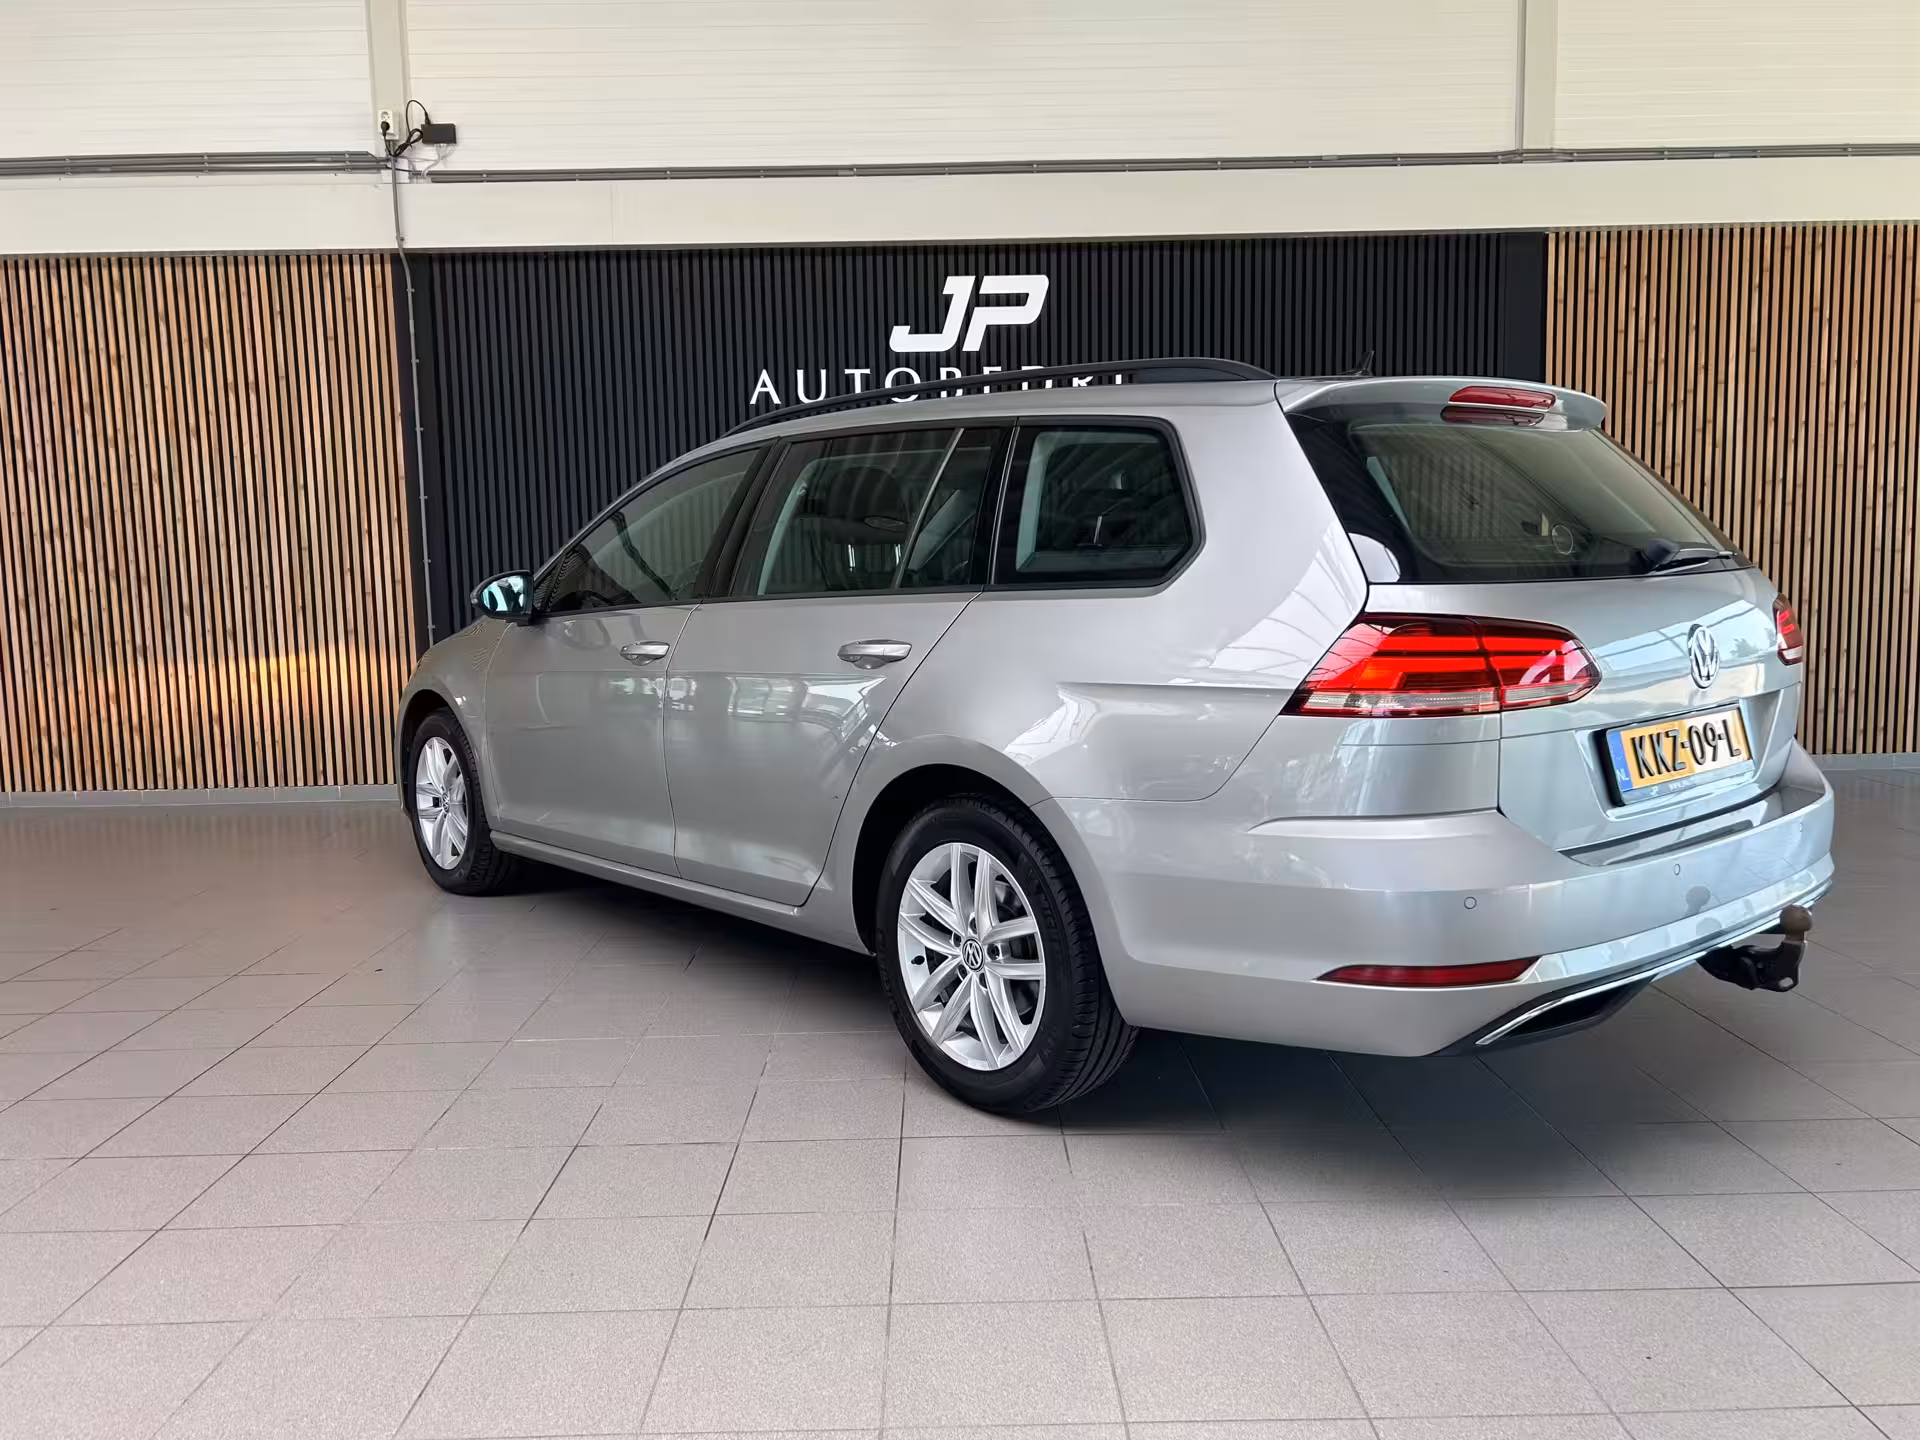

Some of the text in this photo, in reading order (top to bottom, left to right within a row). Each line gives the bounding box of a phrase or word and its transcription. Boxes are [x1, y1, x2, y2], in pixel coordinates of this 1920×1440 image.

[889, 274, 1050, 353] JP
[749, 365, 1123, 405] AUTOB
[1630, 719, 1741, 779] KKZ-09-L
[1616, 768, 1630, 781] NL
